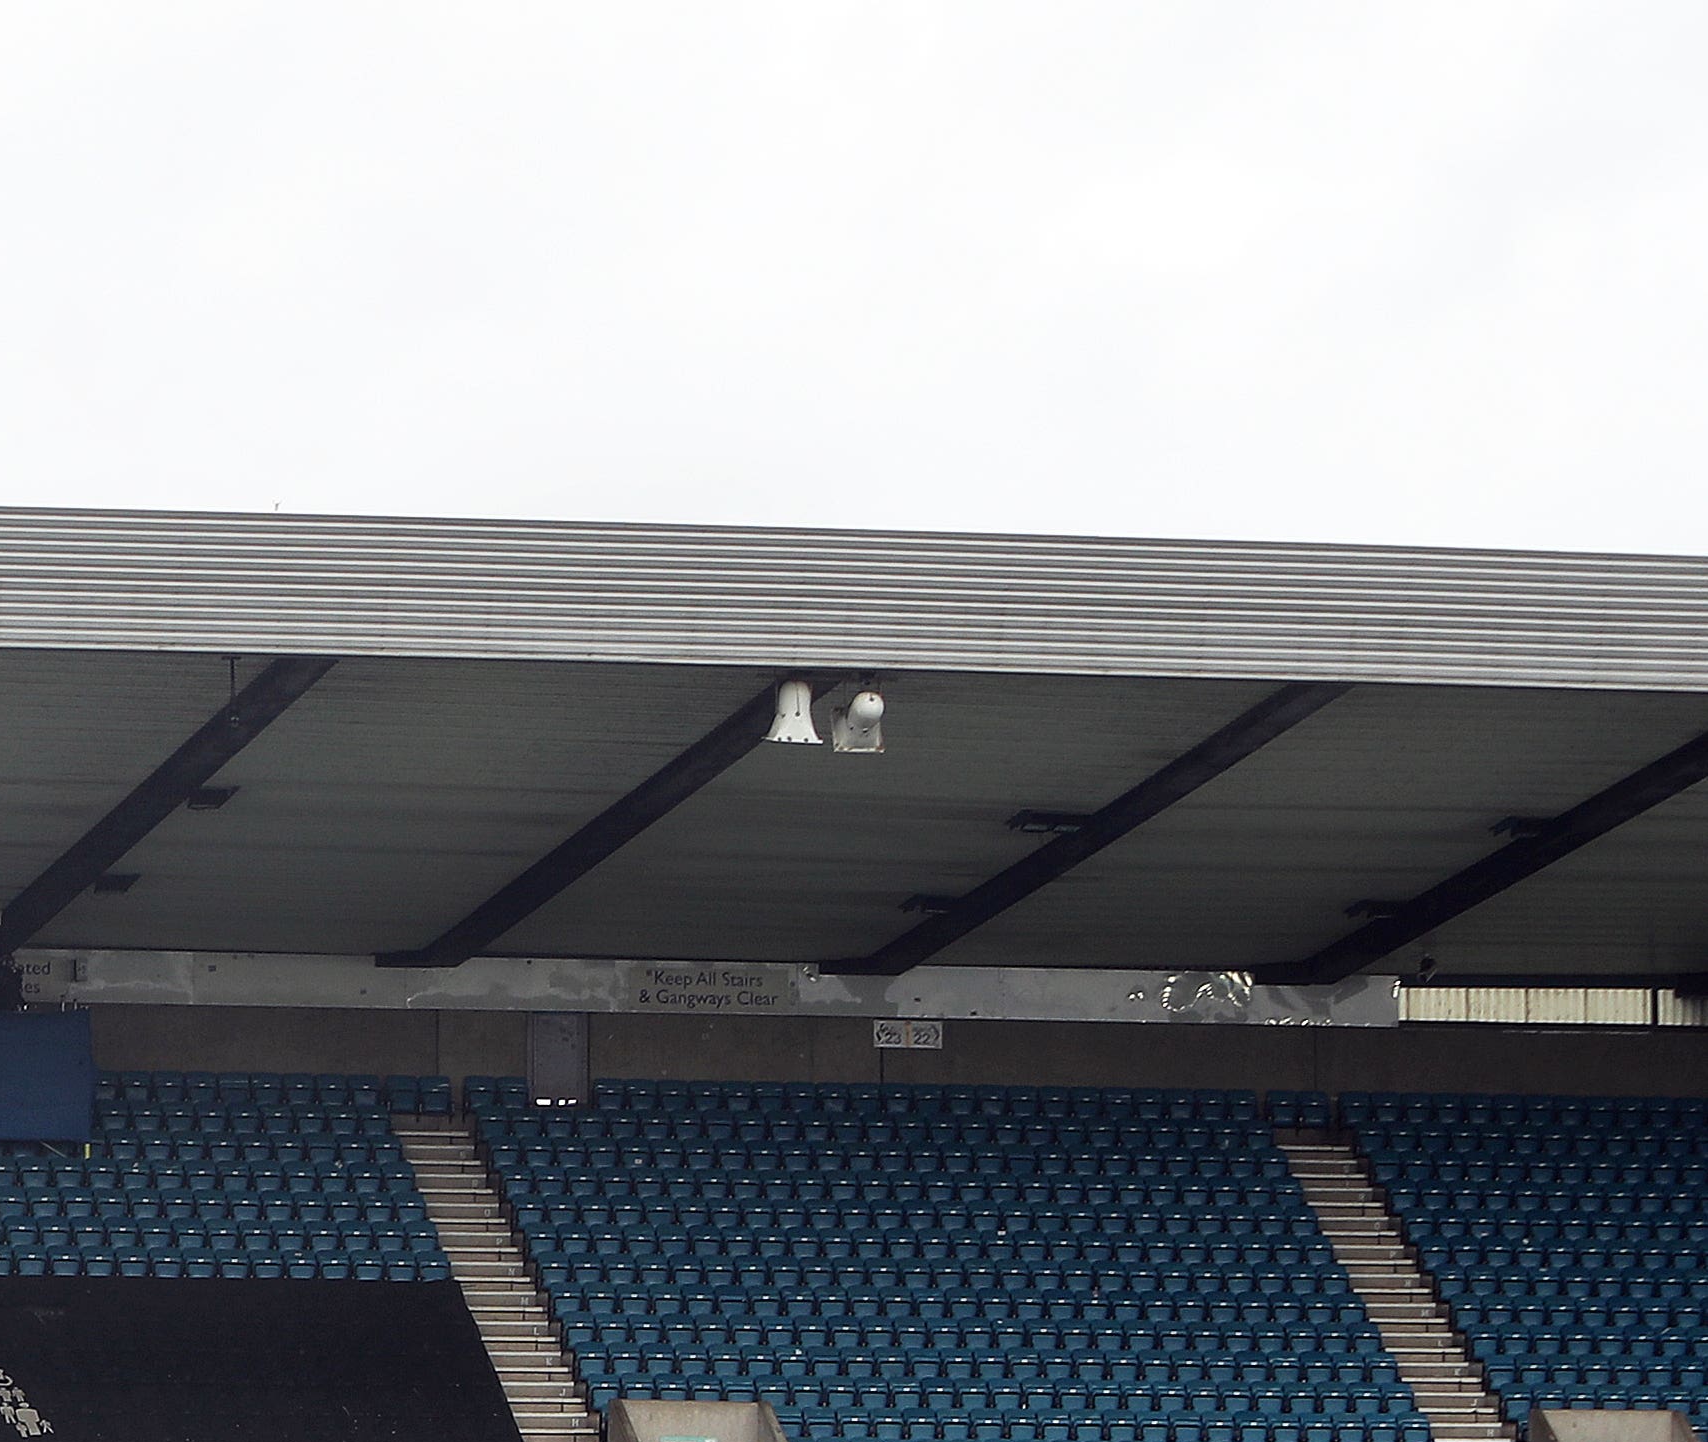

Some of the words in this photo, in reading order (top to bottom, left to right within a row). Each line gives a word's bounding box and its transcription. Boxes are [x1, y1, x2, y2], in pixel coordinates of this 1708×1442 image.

[654, 970, 693, 989] Keep
[696, 972, 716, 986] All
[722, 972, 763, 987] Stairs
[656, 989, 731, 1008] Gangways
[737, 991, 778, 1006] Clear
